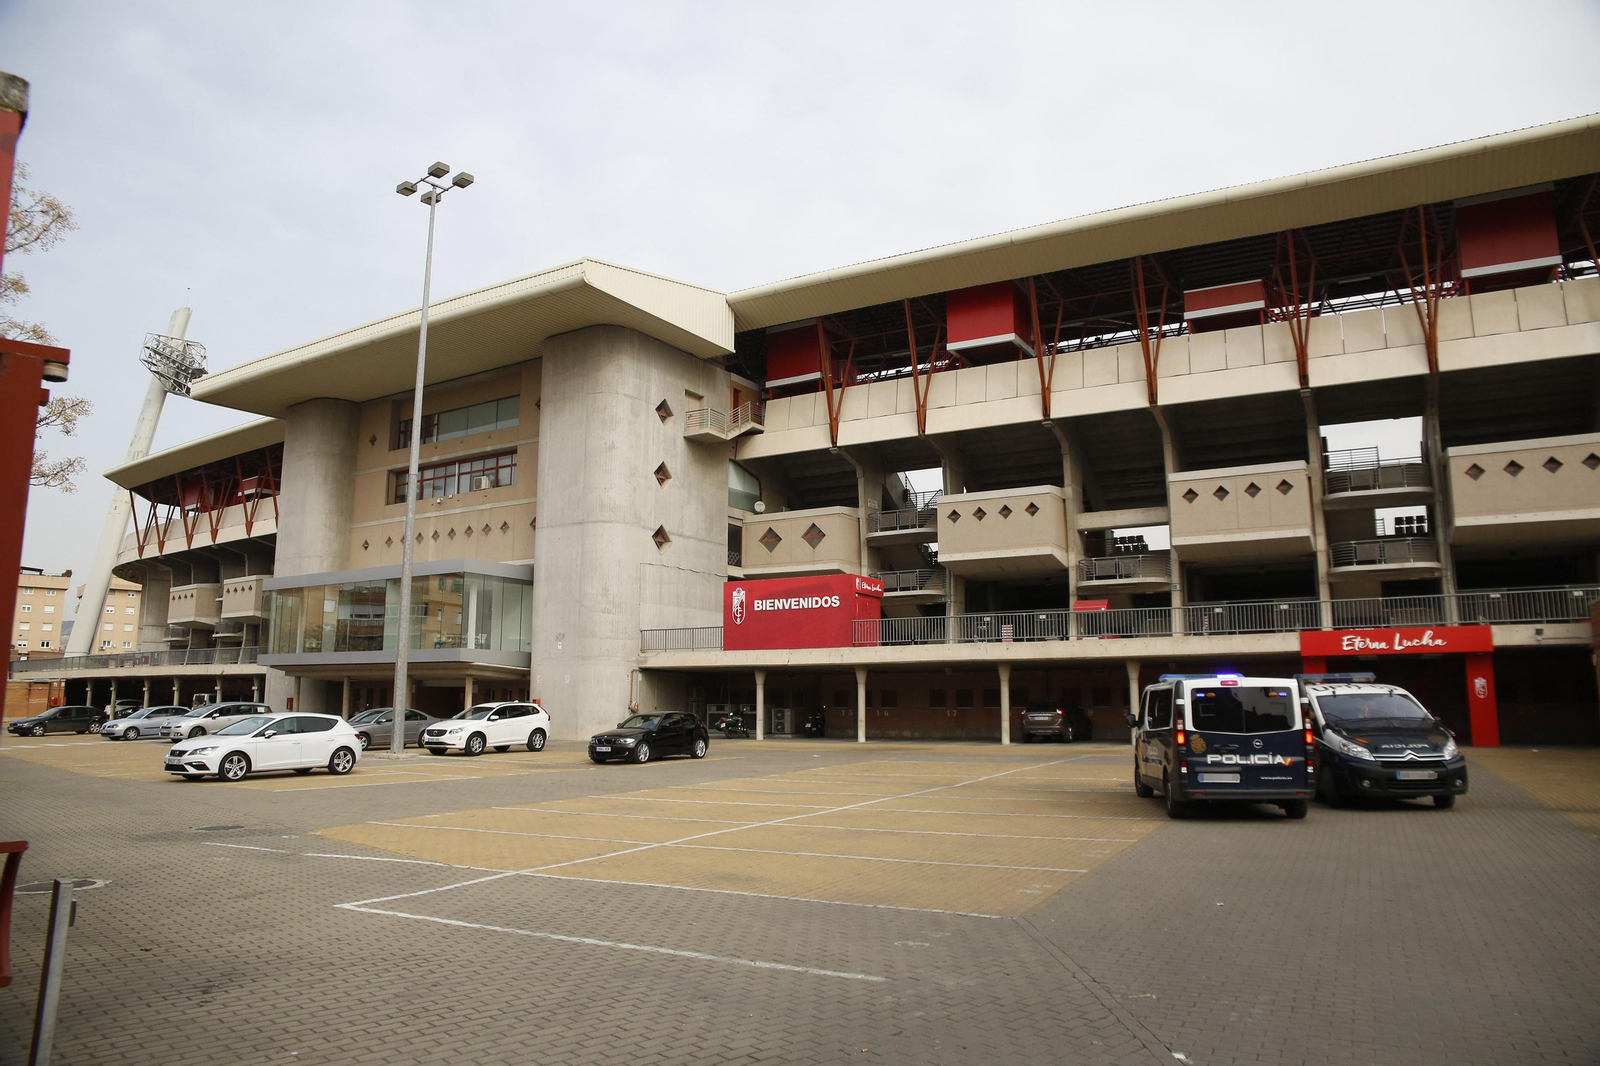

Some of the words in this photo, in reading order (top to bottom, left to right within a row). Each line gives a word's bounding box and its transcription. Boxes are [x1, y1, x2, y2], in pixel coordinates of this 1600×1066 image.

[754, 595, 840, 611] BIENVENIDOS
[1342, 635, 1389, 651] Eterna
[1393, 630, 1447, 650] Lucha
[1207, 752, 1286, 765] POLICÍA
